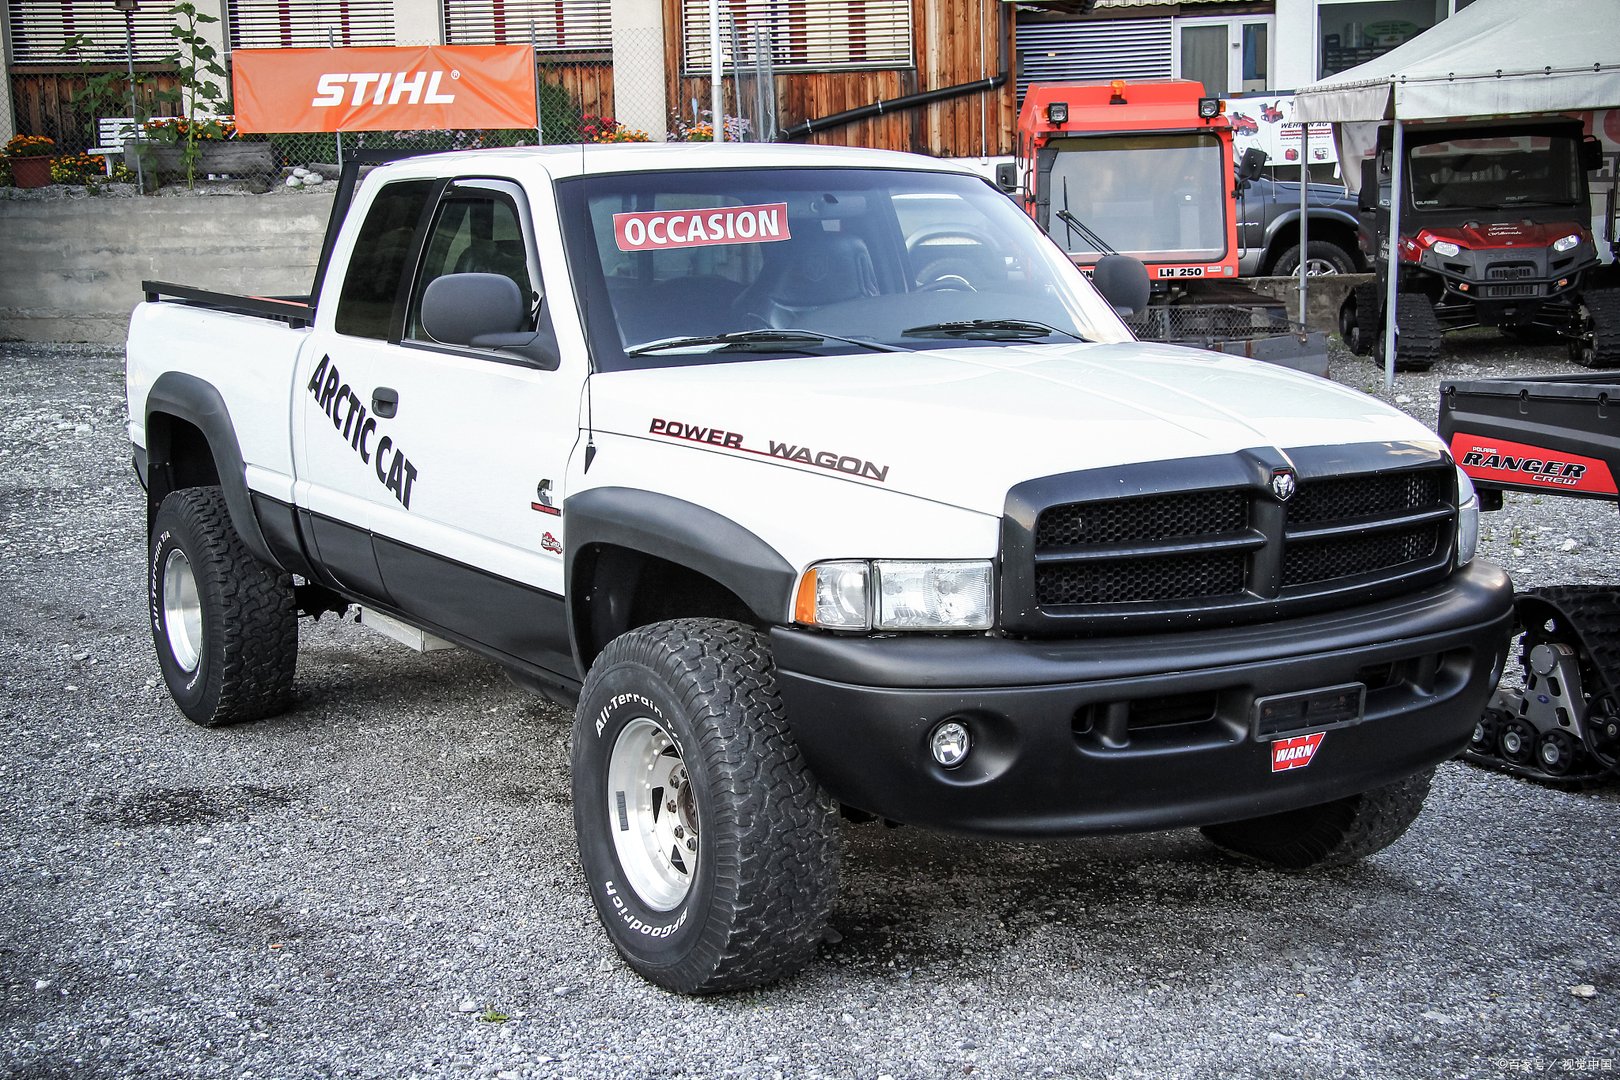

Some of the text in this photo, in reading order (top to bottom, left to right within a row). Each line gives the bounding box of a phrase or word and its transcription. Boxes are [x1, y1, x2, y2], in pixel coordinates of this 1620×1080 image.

[312, 71, 455, 106] STIHL
[624, 209, 780, 245] OCCASION
[1160, 268, 1174, 277] LH
[1180, 267, 1202, 276] 250
[308, 353, 418, 511] ARCTIC CAT
[650, 418, 889, 481] POWER WAGON
[1462, 452, 1587, 479] RANGER
[1472, 446, 1497, 454] POLARIS
[1532, 474, 1577, 485] CREW
[152, 540, 163, 631] All-Terrain
[595, 692, 663, 738] All-Terrain
[1275, 744, 1313, 763] WARN
